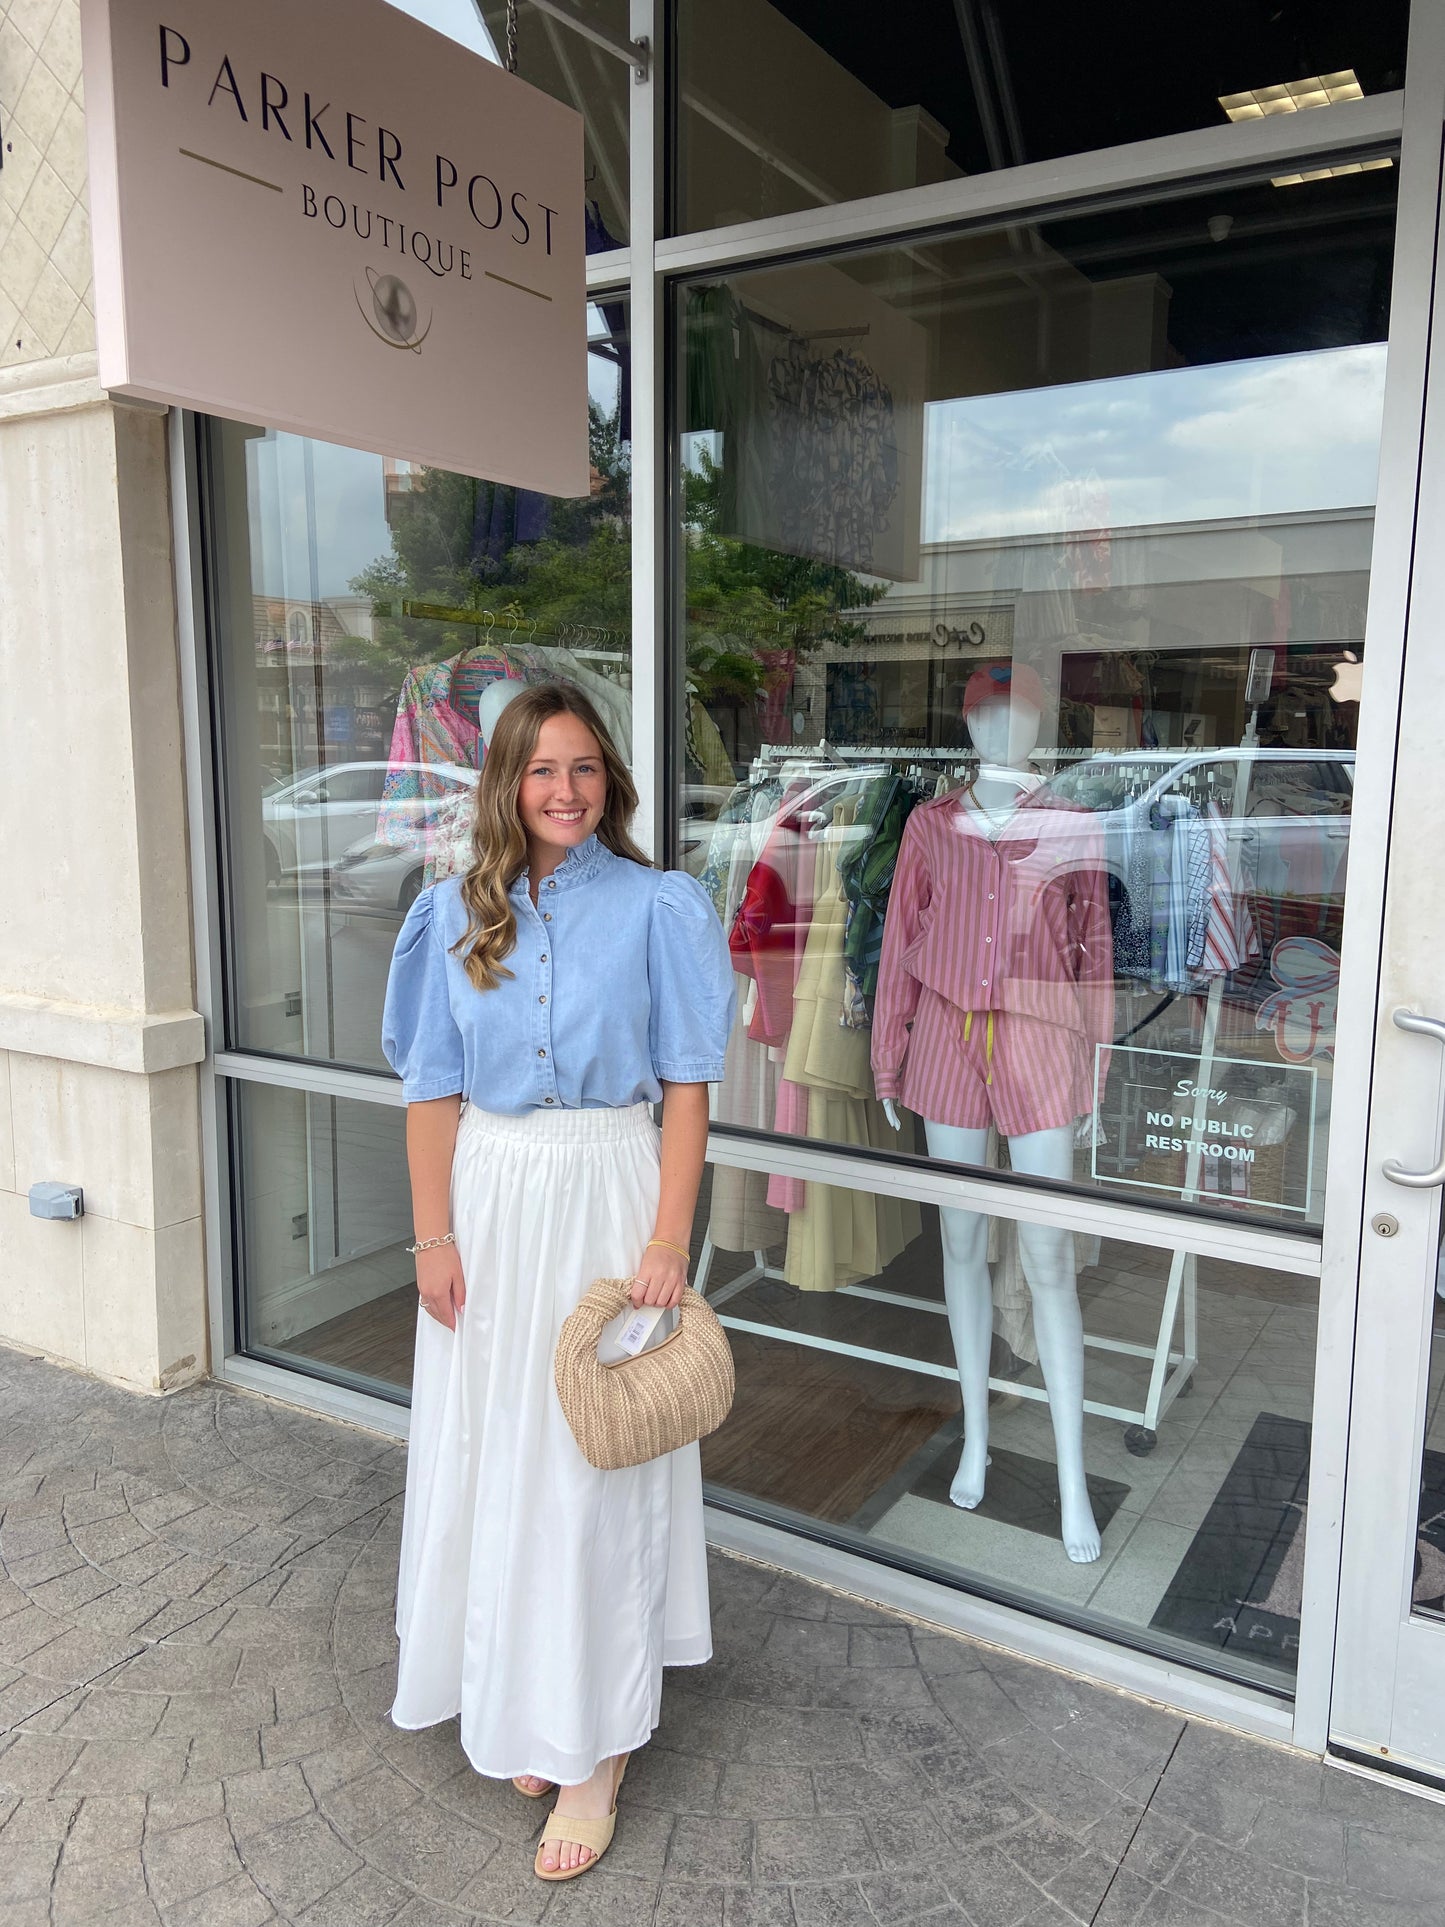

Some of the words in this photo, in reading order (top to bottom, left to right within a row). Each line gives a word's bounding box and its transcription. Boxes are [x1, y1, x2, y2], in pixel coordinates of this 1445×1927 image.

[159, 24, 405, 191] PARKER
[436, 154, 559, 256] POST
[301, 183, 473, 281] BOUTIQUE
[1173, 1080, 1228, 1106] Sorry
[1146, 1112, 1174, 1128] NO
[1180, 1116, 1254, 1139] PUBLIC
[1145, 1134, 1255, 1162] RESTROOM
